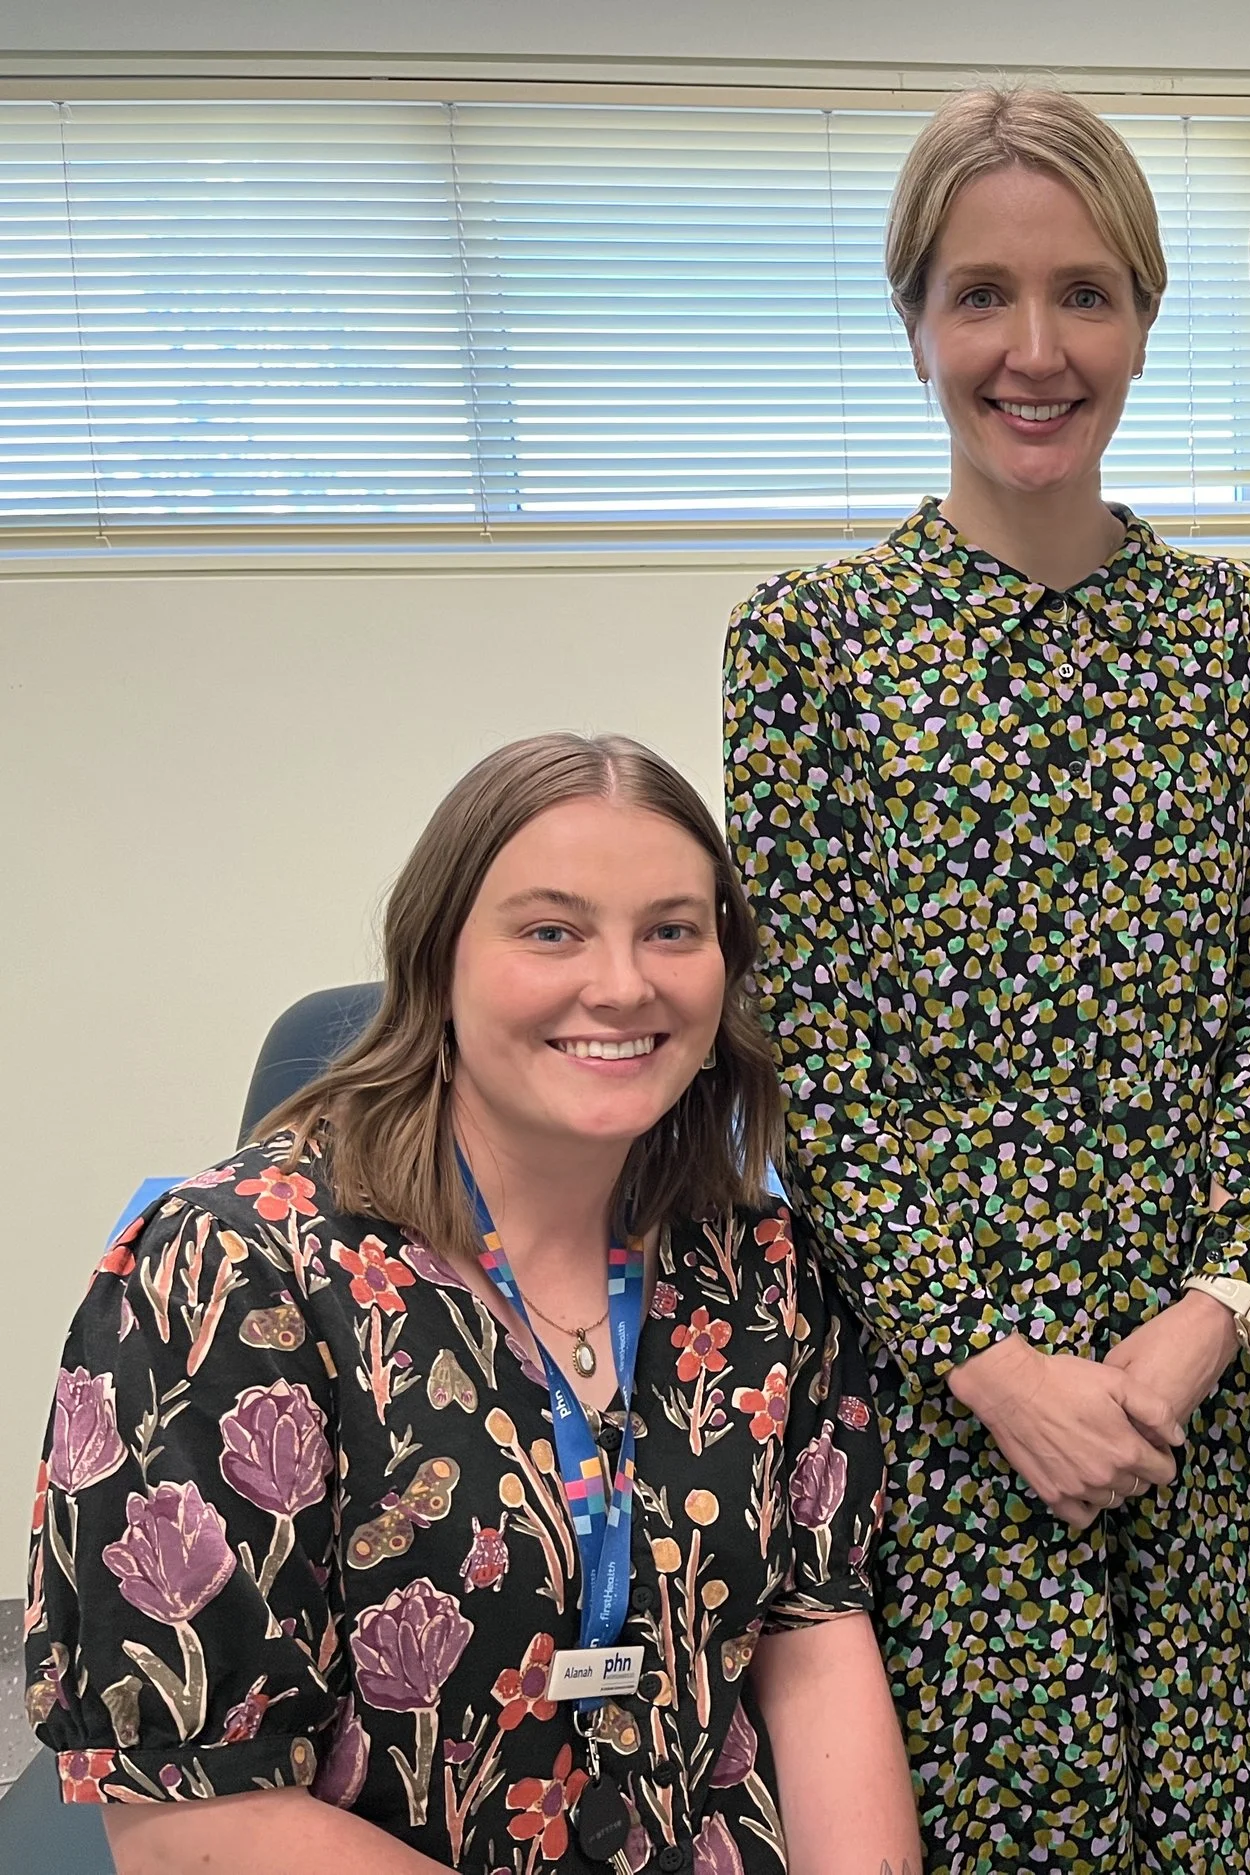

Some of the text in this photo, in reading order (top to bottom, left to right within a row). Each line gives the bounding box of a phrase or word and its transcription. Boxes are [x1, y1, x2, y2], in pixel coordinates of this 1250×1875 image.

[555, 1389, 572, 1419] phn
[564, 1652, 632, 1680] Alanah phn
